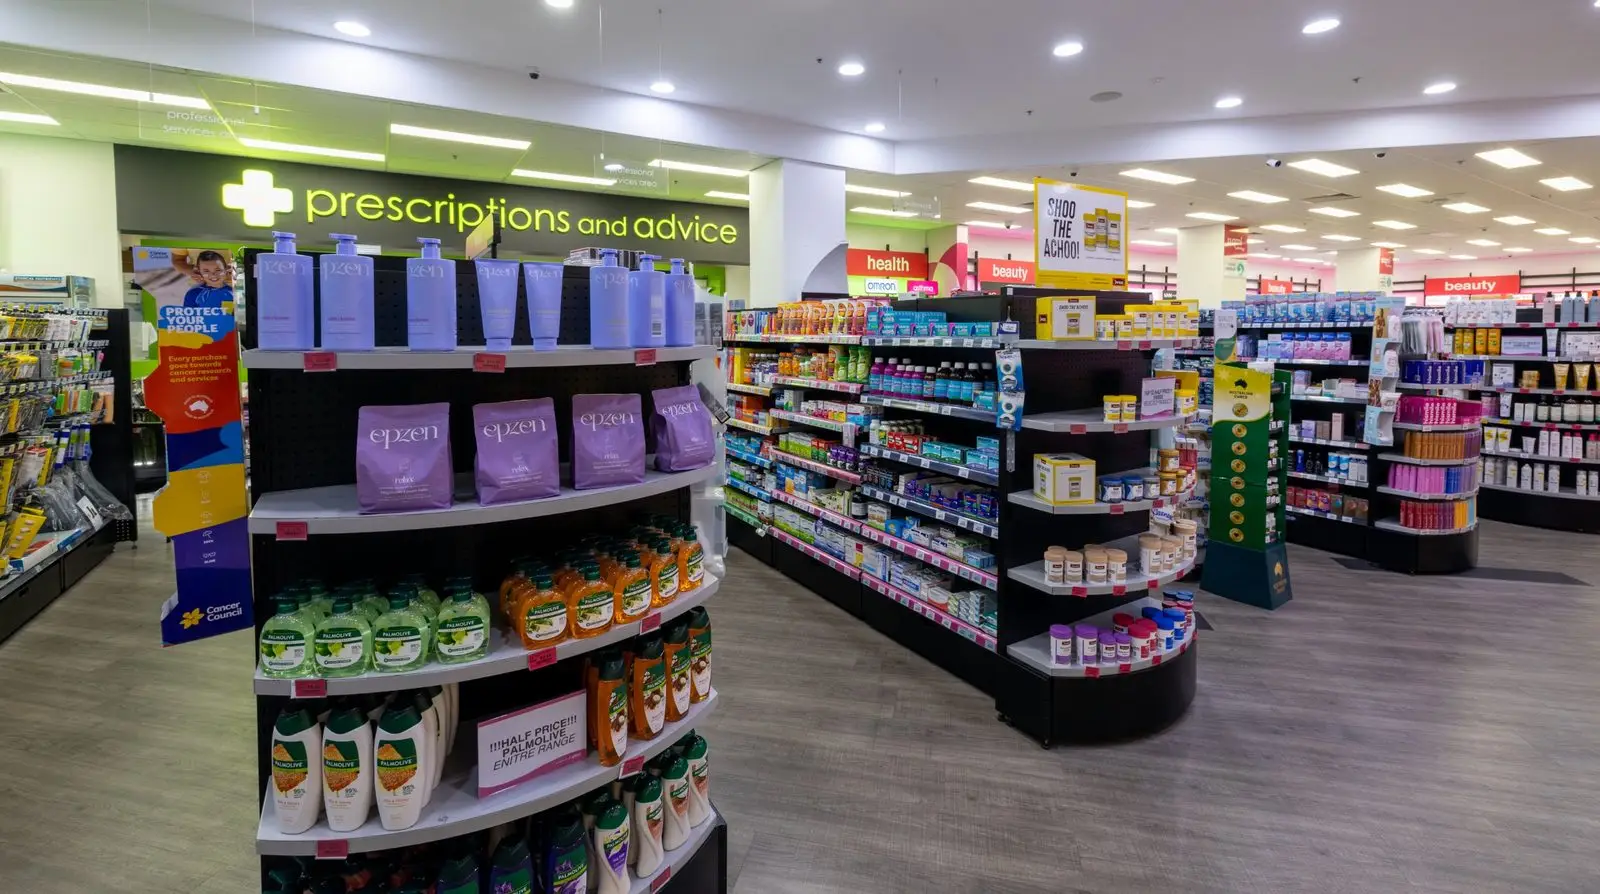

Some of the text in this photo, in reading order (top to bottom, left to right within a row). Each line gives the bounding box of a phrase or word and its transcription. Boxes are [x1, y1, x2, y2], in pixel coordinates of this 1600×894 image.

[305, 187, 738, 245] prescriptions and advice
[1047, 198, 1077, 219] SHOO
[1053, 219, 1073, 239] THE
[1044, 238, 1080, 260] ACHOO!
[321, 261, 370, 280] pzen
[866, 254, 910, 272] health
[992, 264, 1028, 282] beauty
[1444, 280, 1496, 292] beauty
[165, 307, 229, 317] PROTECT
[166, 316, 205, 325] YOUR
[167, 324, 219, 333] PEOPLE
[168, 354, 228, 363] Every purchase
[661, 401, 701, 420] epzen
[483, 418, 547, 443] epzen
[580, 411, 636, 432] epzen
[369, 425, 439, 450] epzen
[206, 602, 241, 615] Cancer
[207, 608, 243, 622] Council
[446, 620, 475, 628] PALMOLIVE
[489, 714, 577, 753] !!!HALF PRICE!!!
[502, 728, 567, 757] PALMOLIVE
[493, 747, 536, 771] ENITRE
[538, 733, 576, 756] RANGE
[381, 759, 412, 767] PALMOLIVE
[557, 863, 584, 880] PALMOLIVE
